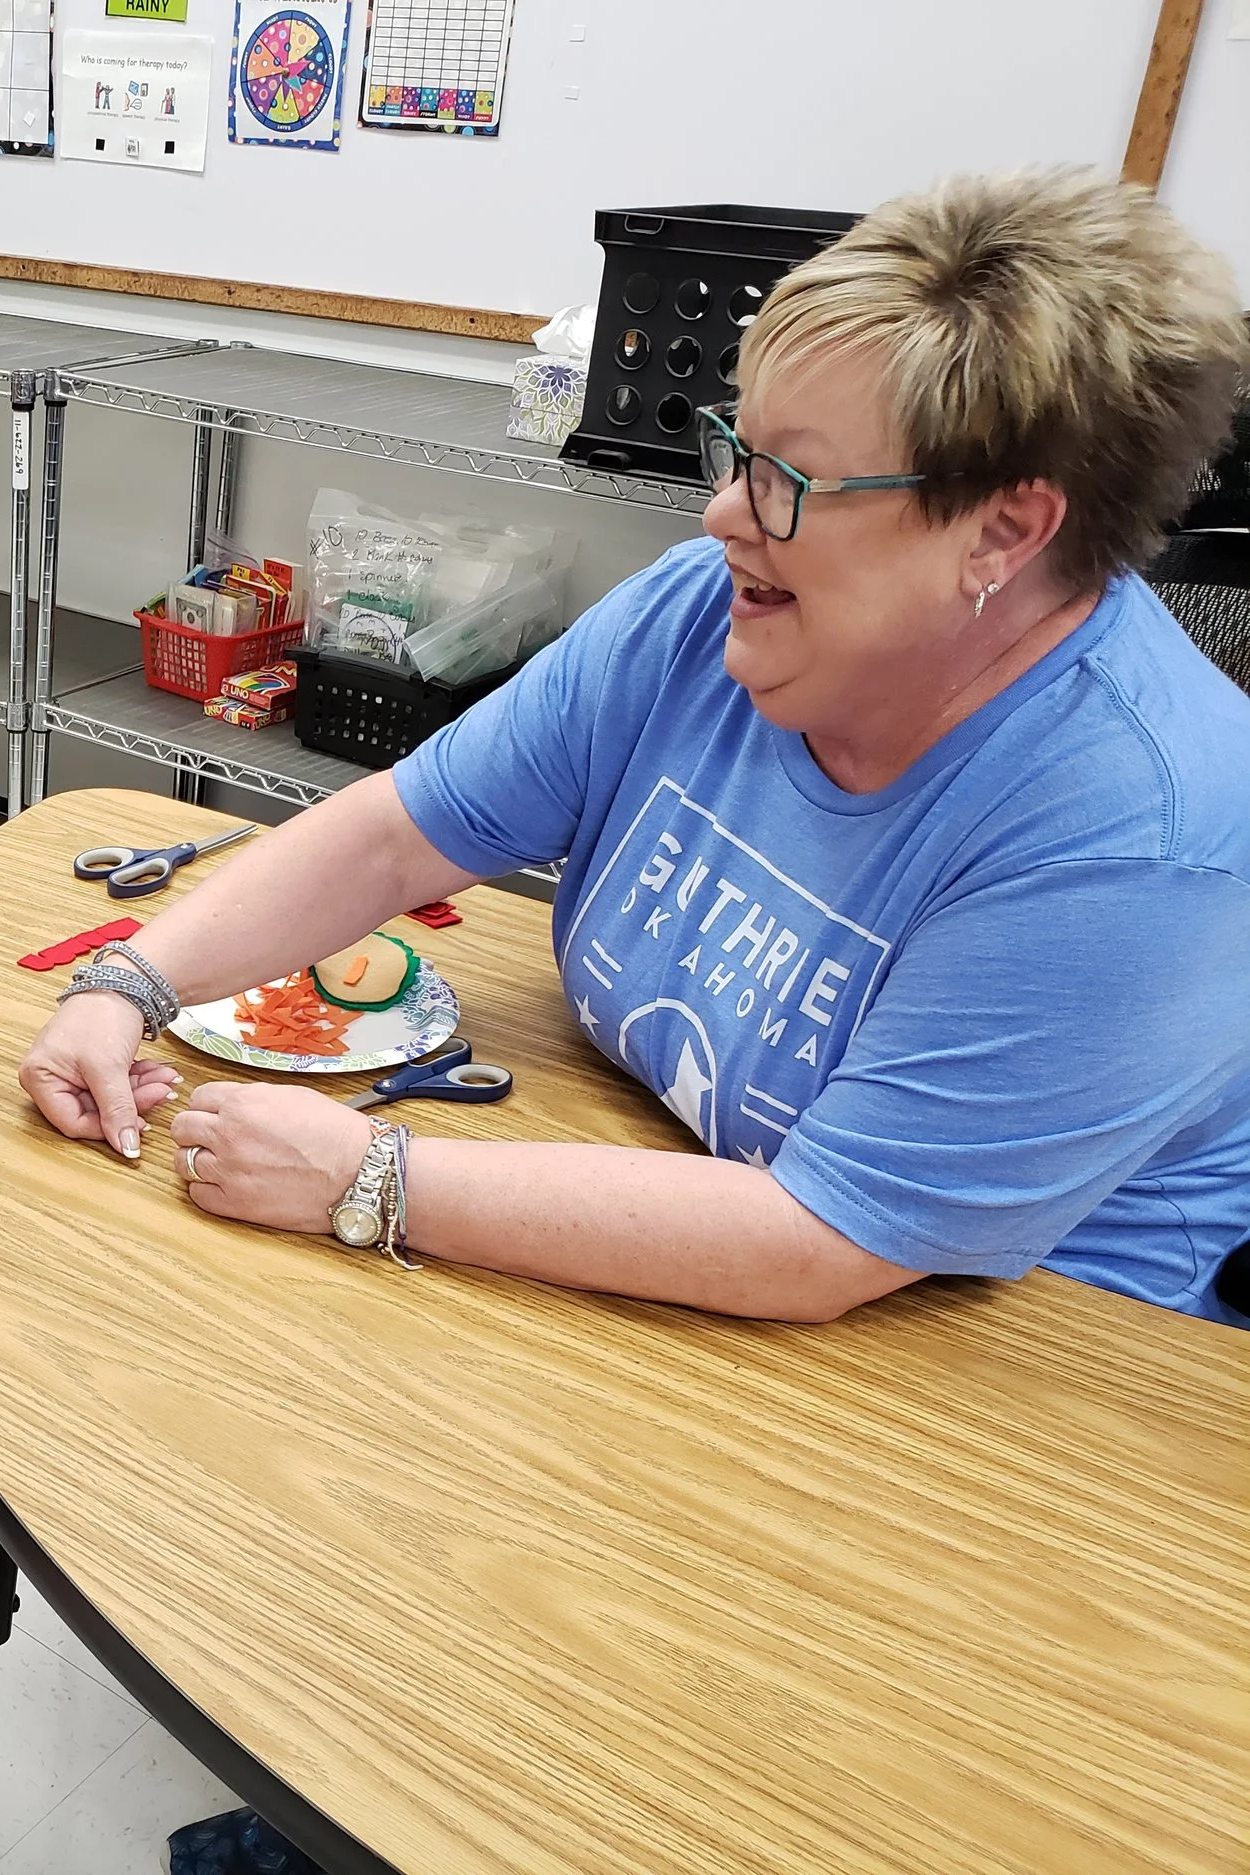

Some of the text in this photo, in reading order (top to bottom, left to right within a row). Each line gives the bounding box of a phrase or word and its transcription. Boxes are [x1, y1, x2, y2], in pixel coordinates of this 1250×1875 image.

[126, 0, 169, 13] RAINY
[80, 56, 95, 64] Who
[103, 58, 125, 69] coming
[127, 58, 137, 67] for
[139, 59, 164, 70] therapy
[166, 60, 188, 72] today?
[230, 685, 249, 699] UNO
[203, 704, 223, 717] UNO
[254, 713, 271, 730] UNO
[638, 831, 851, 1027] GUTHRIE
[620, 886, 819, 1067] OKAHOMA
